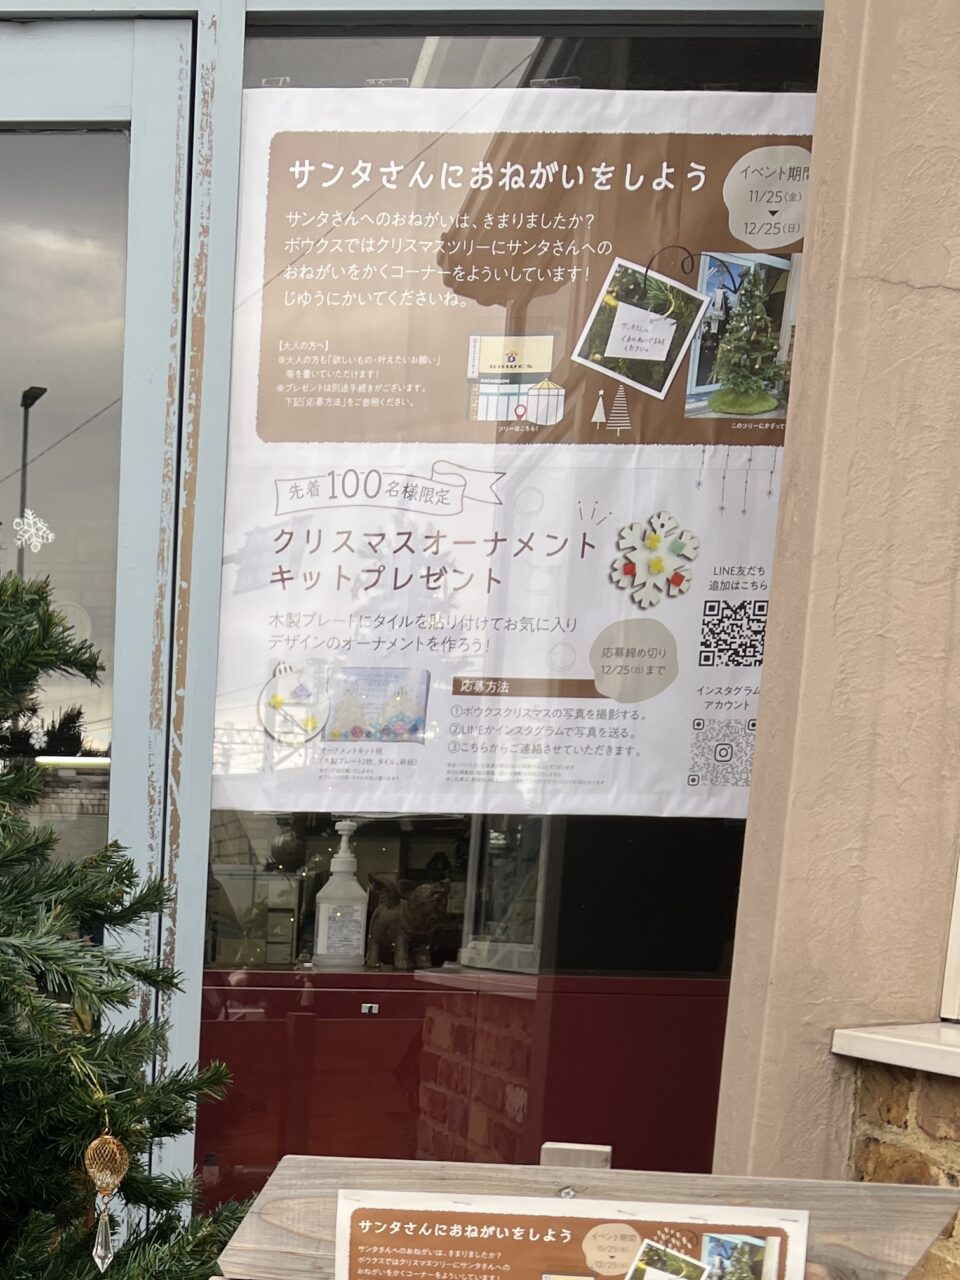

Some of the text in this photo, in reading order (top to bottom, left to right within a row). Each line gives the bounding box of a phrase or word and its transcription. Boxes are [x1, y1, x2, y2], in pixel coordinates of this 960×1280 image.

[289, 159, 707, 192] サンタさんにおねがいをしよう
[748, 189, 803, 203] 11/25(金)
[285, 210, 595, 230] サンタさんへのおねがいは、きまりましたか？
[743, 221, 801, 236] 12/25(日)
[283, 236, 613, 257] ボウクスではクリスマスツリーにサンタさんへの
[283, 263, 590, 283] おねがいをかくコーナーをよういしています！
[284, 290, 467, 308] じゆうにかいてくださいね。
[279, 339, 329, 351] 【大人の方へ】
[288, 468, 451, 506] 先着100名様限定
[274, 528, 596, 559] クリスマスオーナメント
[270, 564, 502, 594] キットプレゼント
[713, 565, 766, 576] LINE友だち
[708, 580, 768, 592] 追加はこちら
[268, 611, 578, 633] 木製プレートにタイルを貼り付けてお気に入り
[268, 635, 490, 653] デザインのオーナメントを作ろう！
[601, 647, 667, 659] 応募締め切り
[460, 679, 510, 694] 応募方法
[696, 685, 761, 696] インスタグラム
[704, 700, 750, 711] アカウント
[358, 1219, 573, 1243] サンタさんにおねがいをしよう
